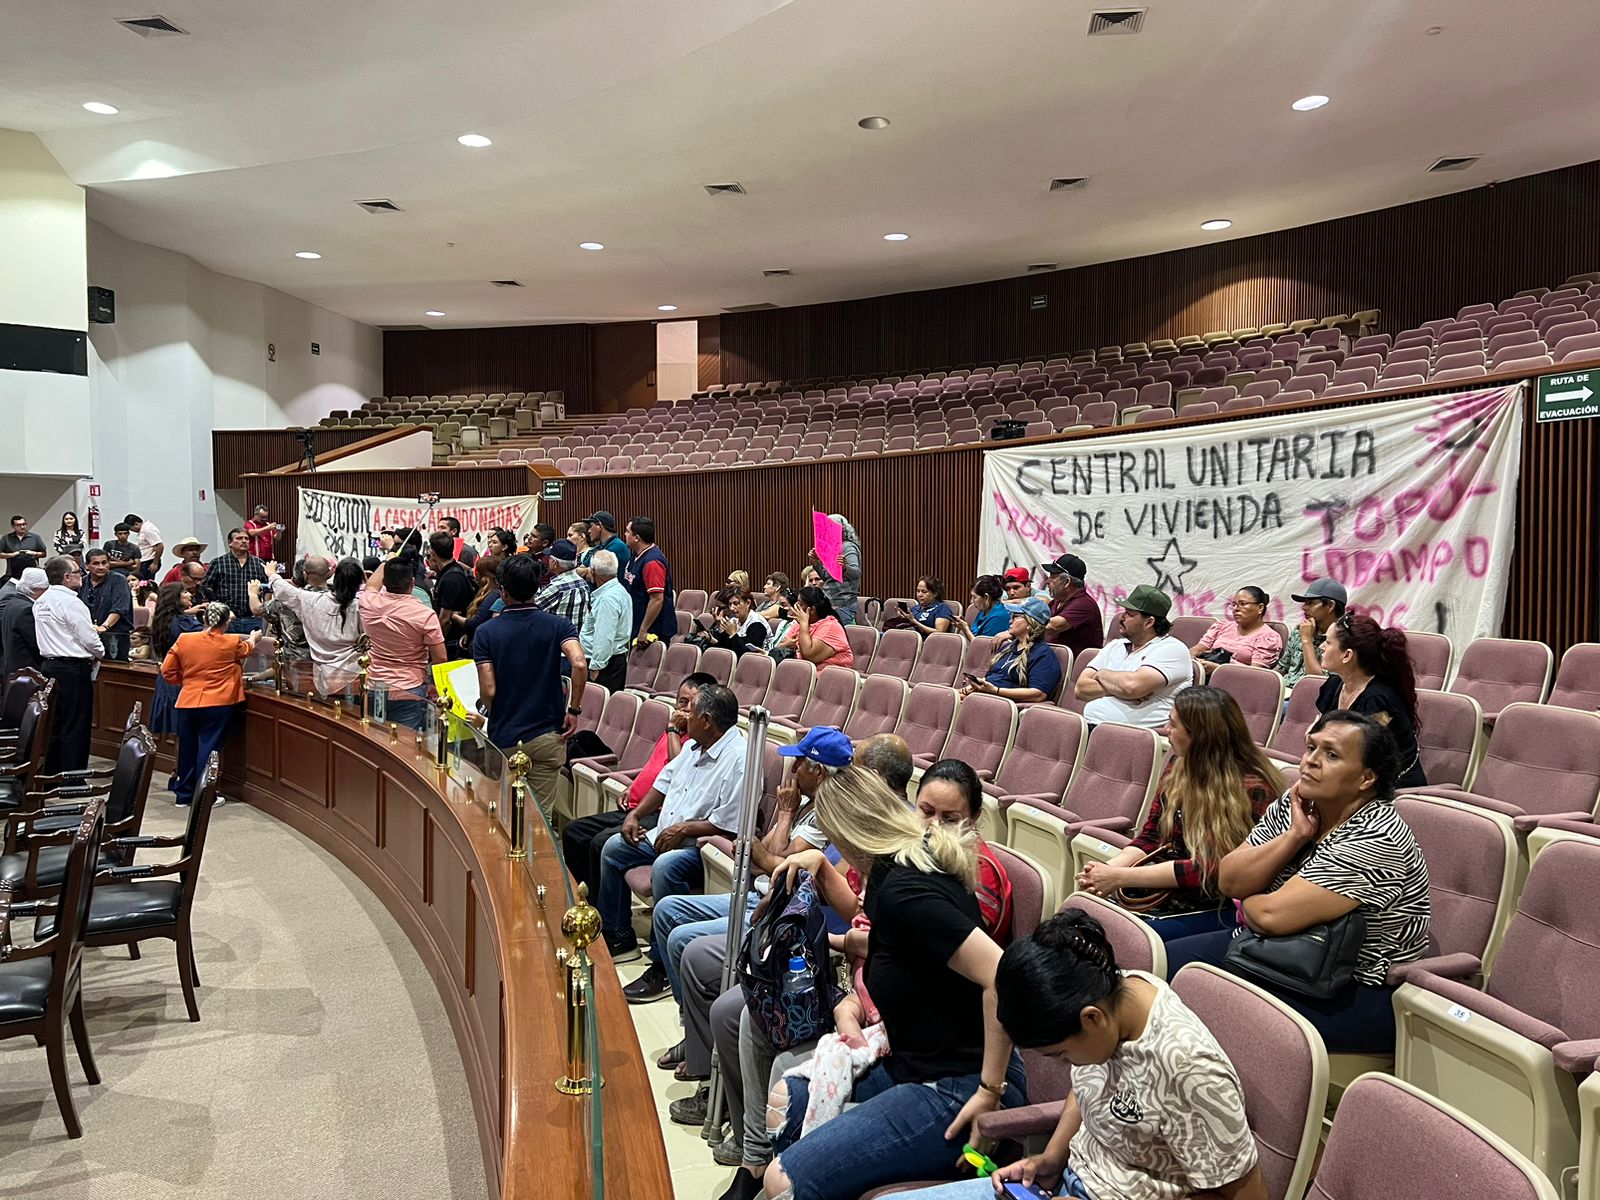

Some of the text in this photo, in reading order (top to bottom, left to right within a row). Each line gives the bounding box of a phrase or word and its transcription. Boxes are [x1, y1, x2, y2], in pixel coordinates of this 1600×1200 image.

[1550, 373, 1590, 386] RUTA DE
[1539, 404, 1599, 419] EVACUACIÓN
[1015, 430, 1377, 496] CENTRAL UNITARIA
[373, 507, 381, 531] A
[1072, 492, 1284, 545] DE VIVIENDA
[1454, 1009, 1466, 1019] 35
